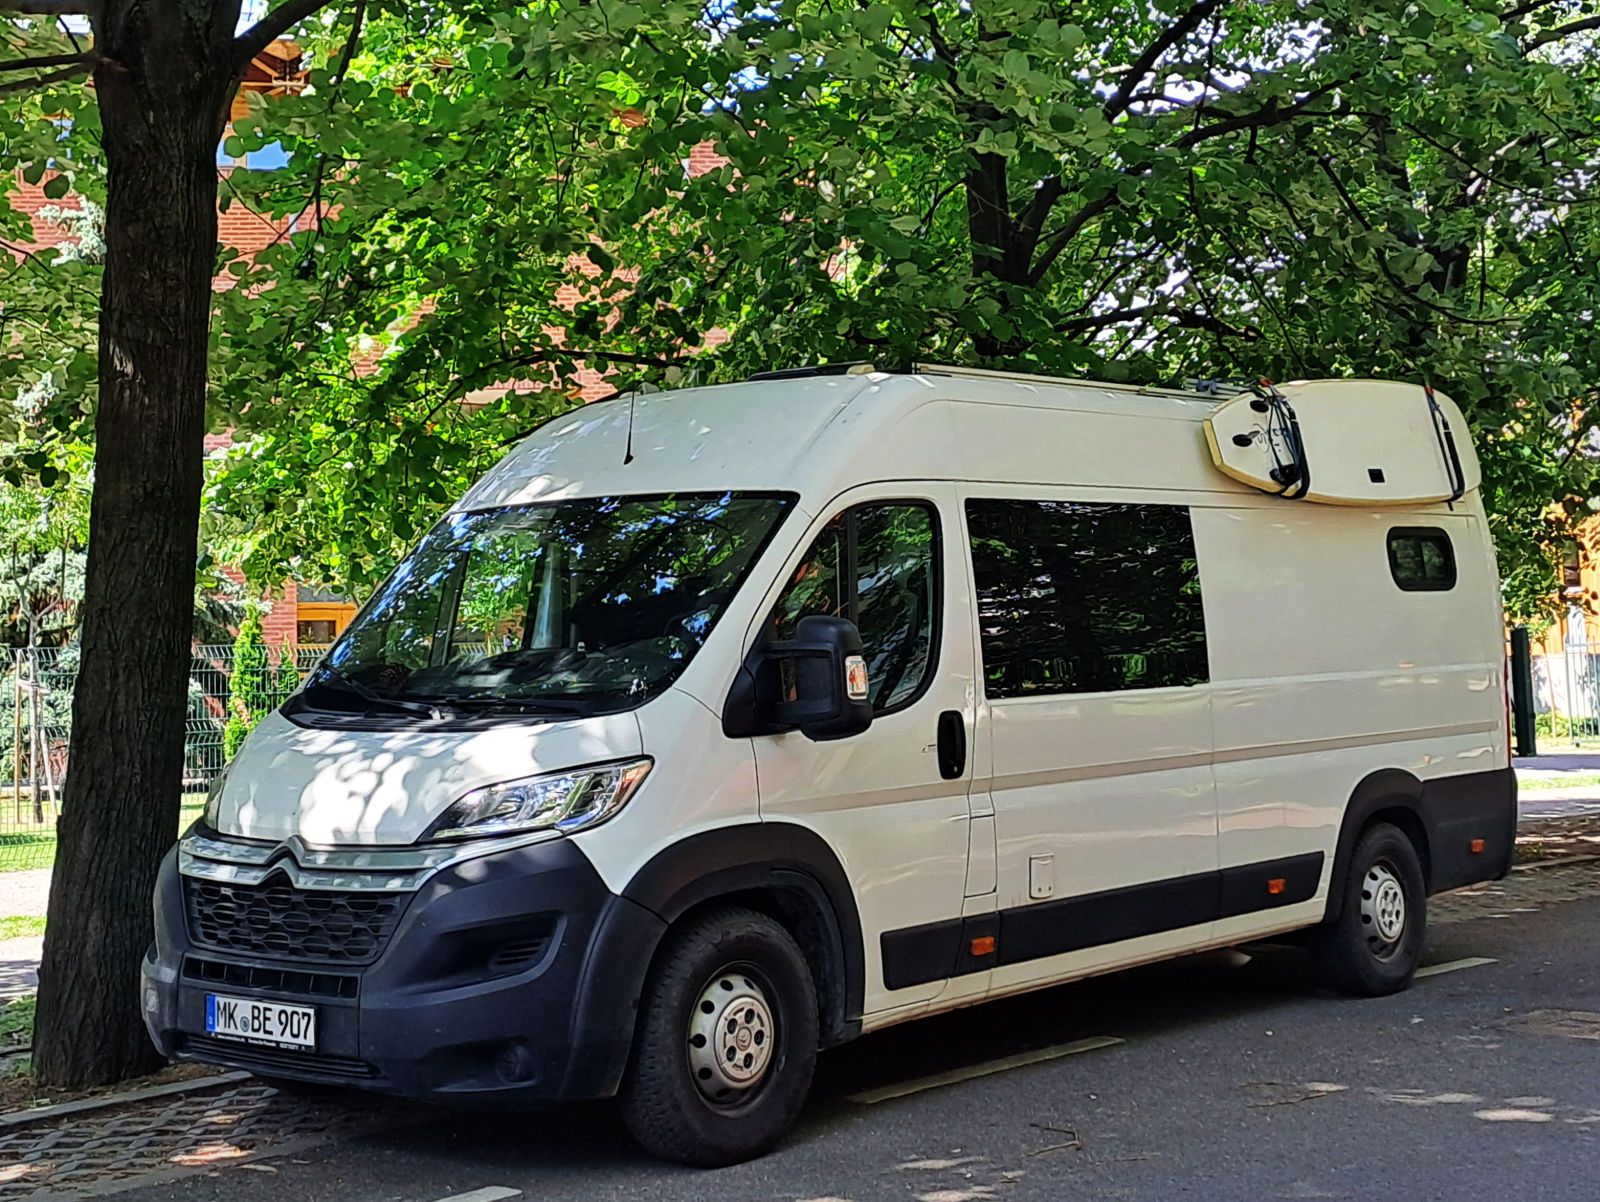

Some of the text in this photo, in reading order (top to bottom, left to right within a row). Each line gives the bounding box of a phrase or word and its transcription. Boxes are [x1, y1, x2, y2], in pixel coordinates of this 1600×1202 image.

[216, 1000, 312, 1040] MK BE 907
